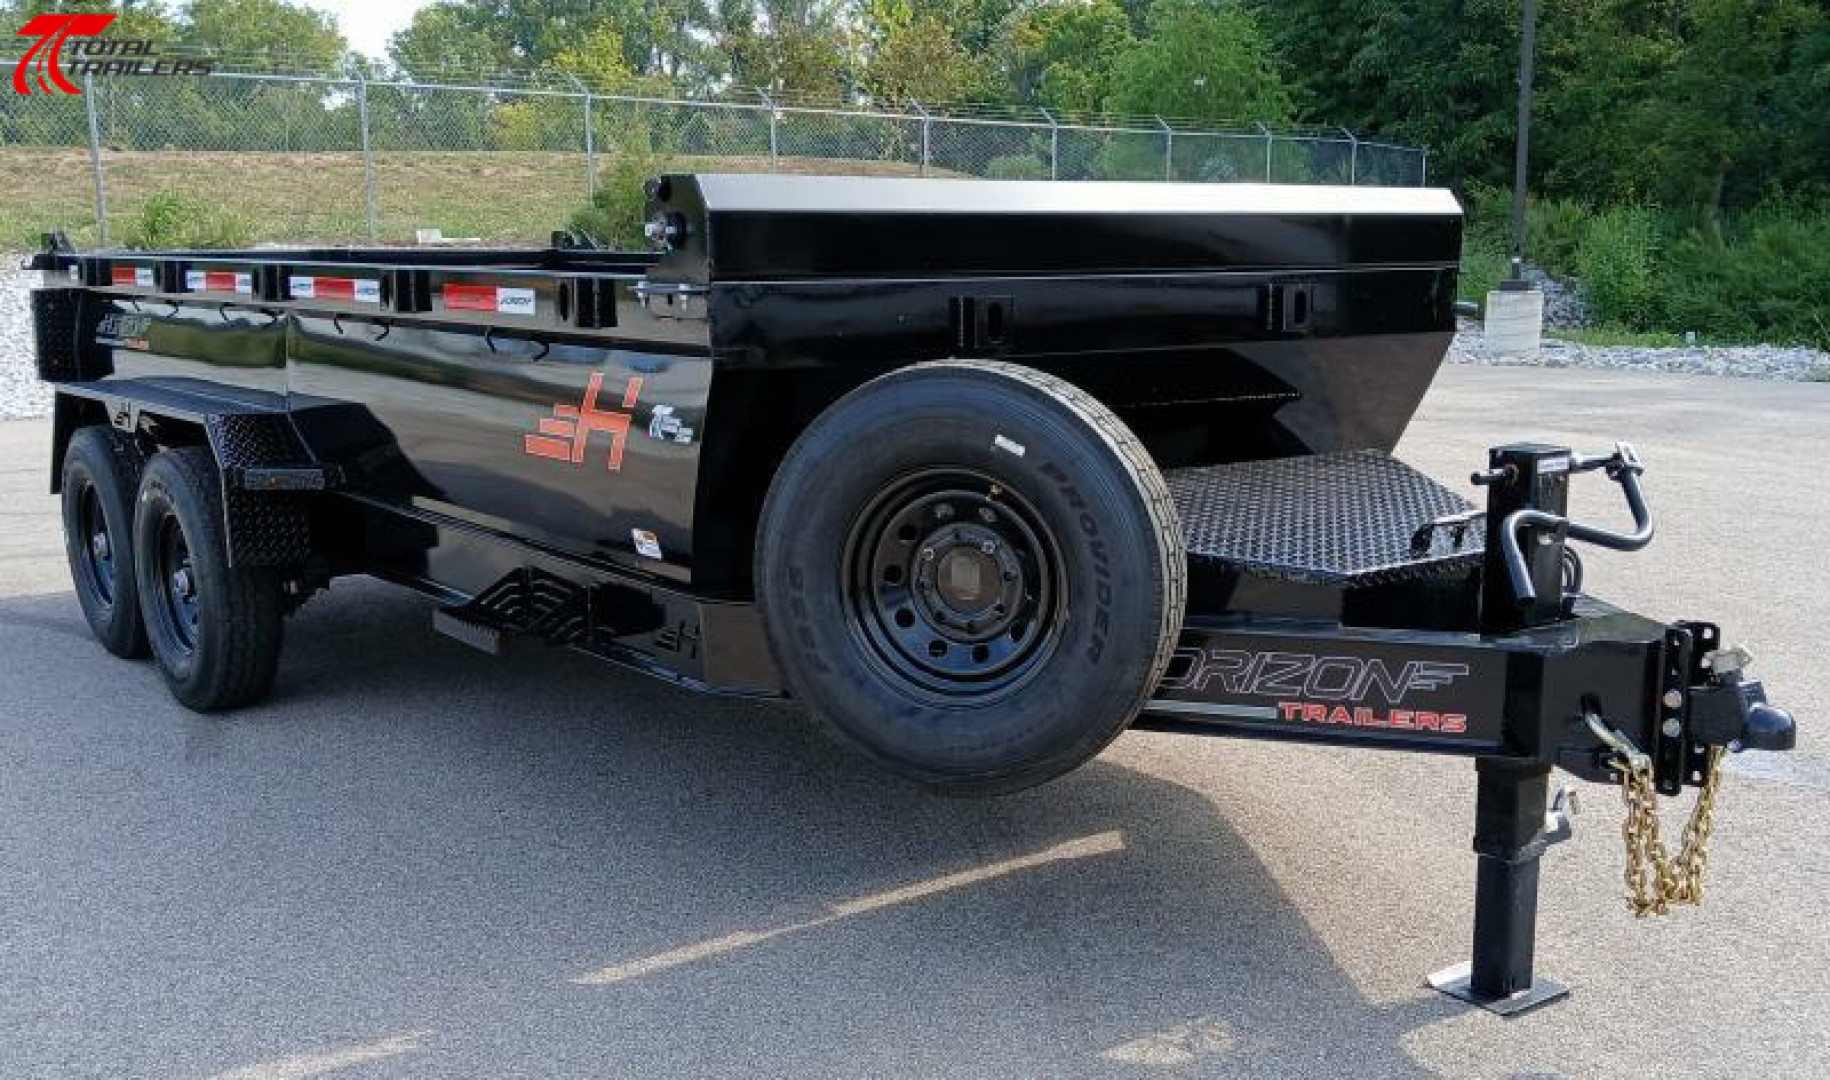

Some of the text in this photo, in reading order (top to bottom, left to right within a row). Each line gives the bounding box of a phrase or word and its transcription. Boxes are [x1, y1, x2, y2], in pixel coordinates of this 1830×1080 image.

[1039, 462, 1113, 664] PROVIDER
[1151, 647, 1418, 703] ORIZON
[1278, 702, 1467, 733] TRAILERS
